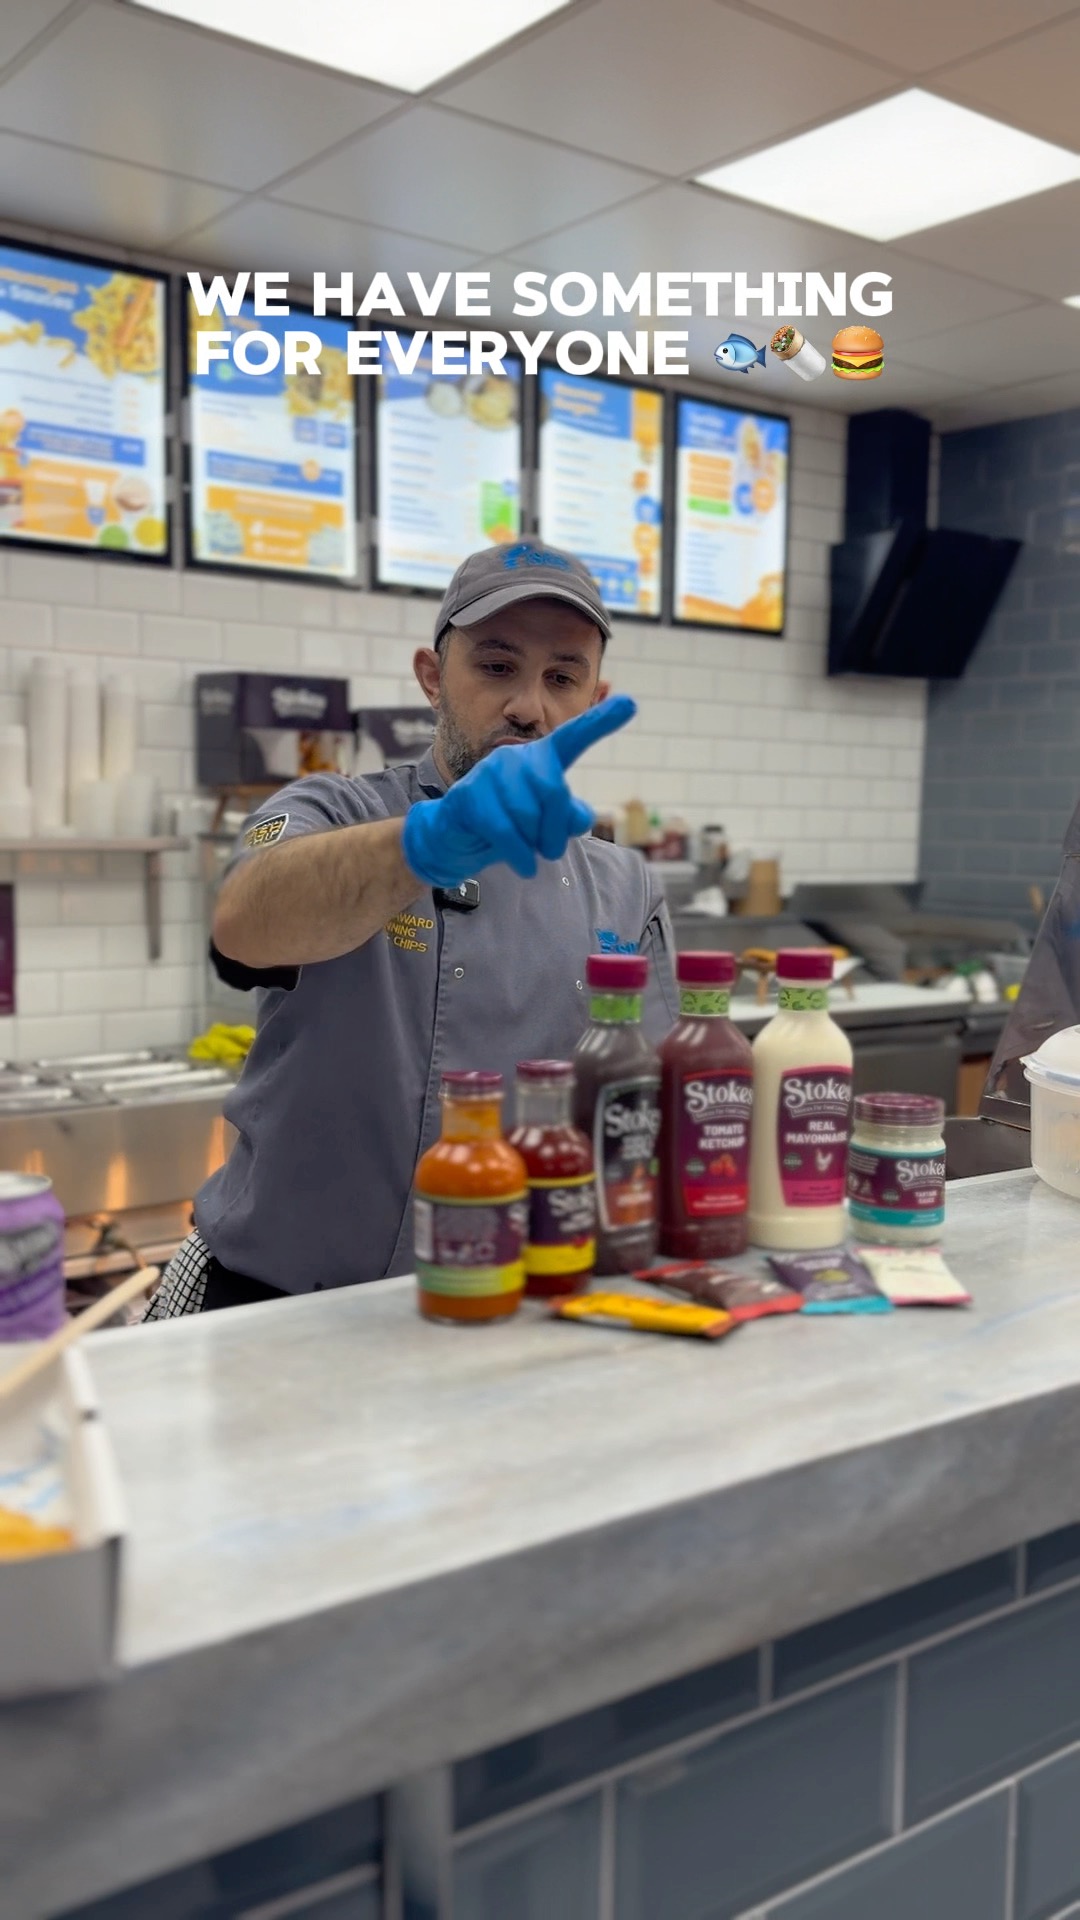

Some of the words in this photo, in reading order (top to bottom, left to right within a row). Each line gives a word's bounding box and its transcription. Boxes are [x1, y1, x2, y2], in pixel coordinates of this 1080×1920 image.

[393, 936, 428, 953] CHIPS
[703, 1123, 744, 1136] TOMATO
[808, 1121, 836, 1131] REAL
[698, 1136, 746, 1149] KETCHUP
